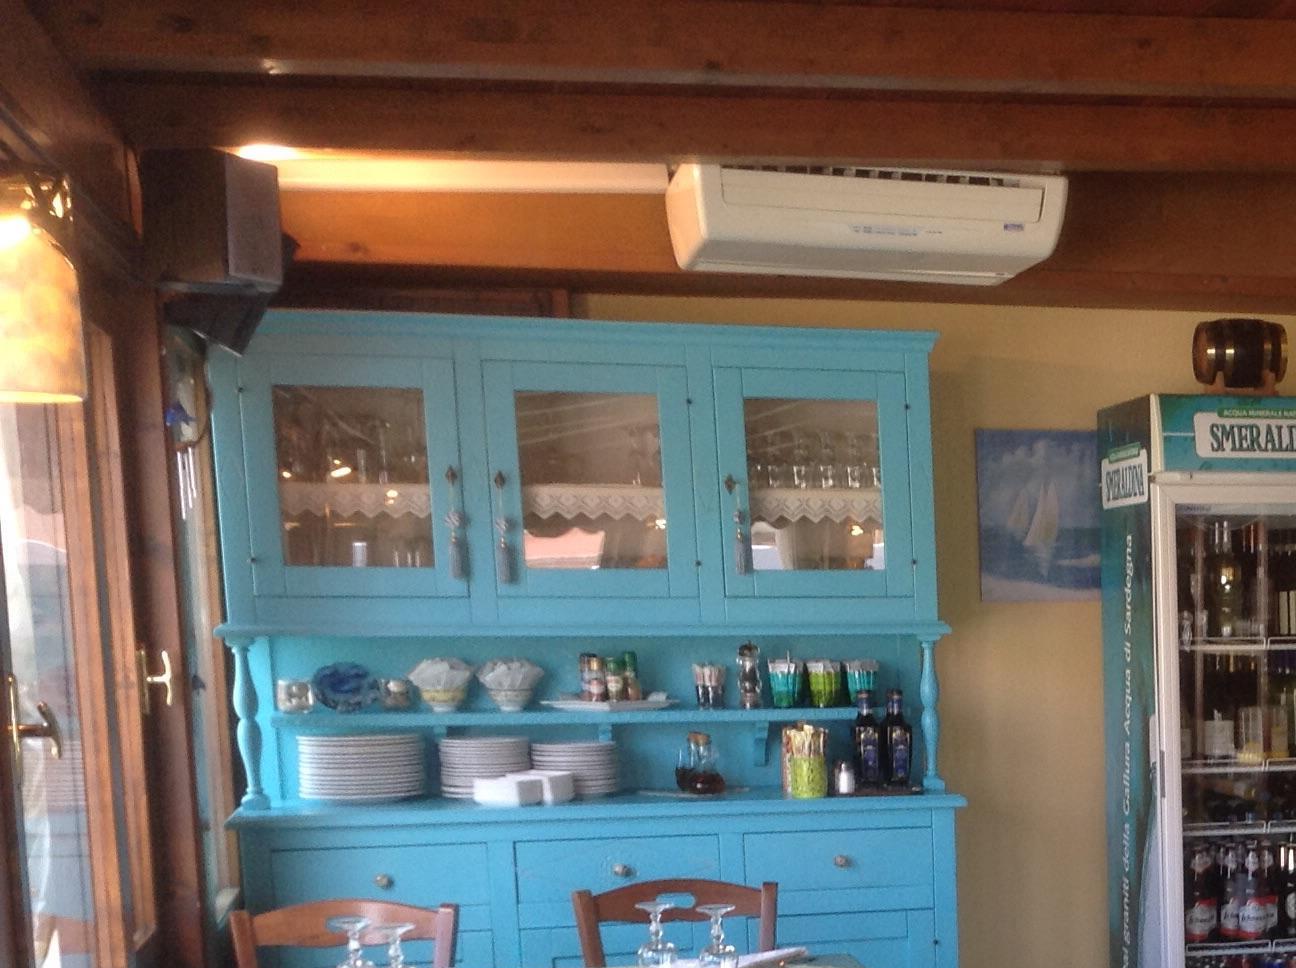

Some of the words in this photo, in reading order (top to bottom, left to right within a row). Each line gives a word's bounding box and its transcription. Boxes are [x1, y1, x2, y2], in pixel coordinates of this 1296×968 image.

[1223, 409, 1248, 417] ACQUA
[1105, 463, 1145, 502] SMERALDINA
[1123, 535, 1134, 636] Sardegna
[1123, 642, 1132, 662] di
[1123, 669, 1132, 735] Acqua
[1122, 742, 1131, 816] Gallura
[1122, 823, 1130, 872] della
[1121, 879, 1131, 945] graniti
